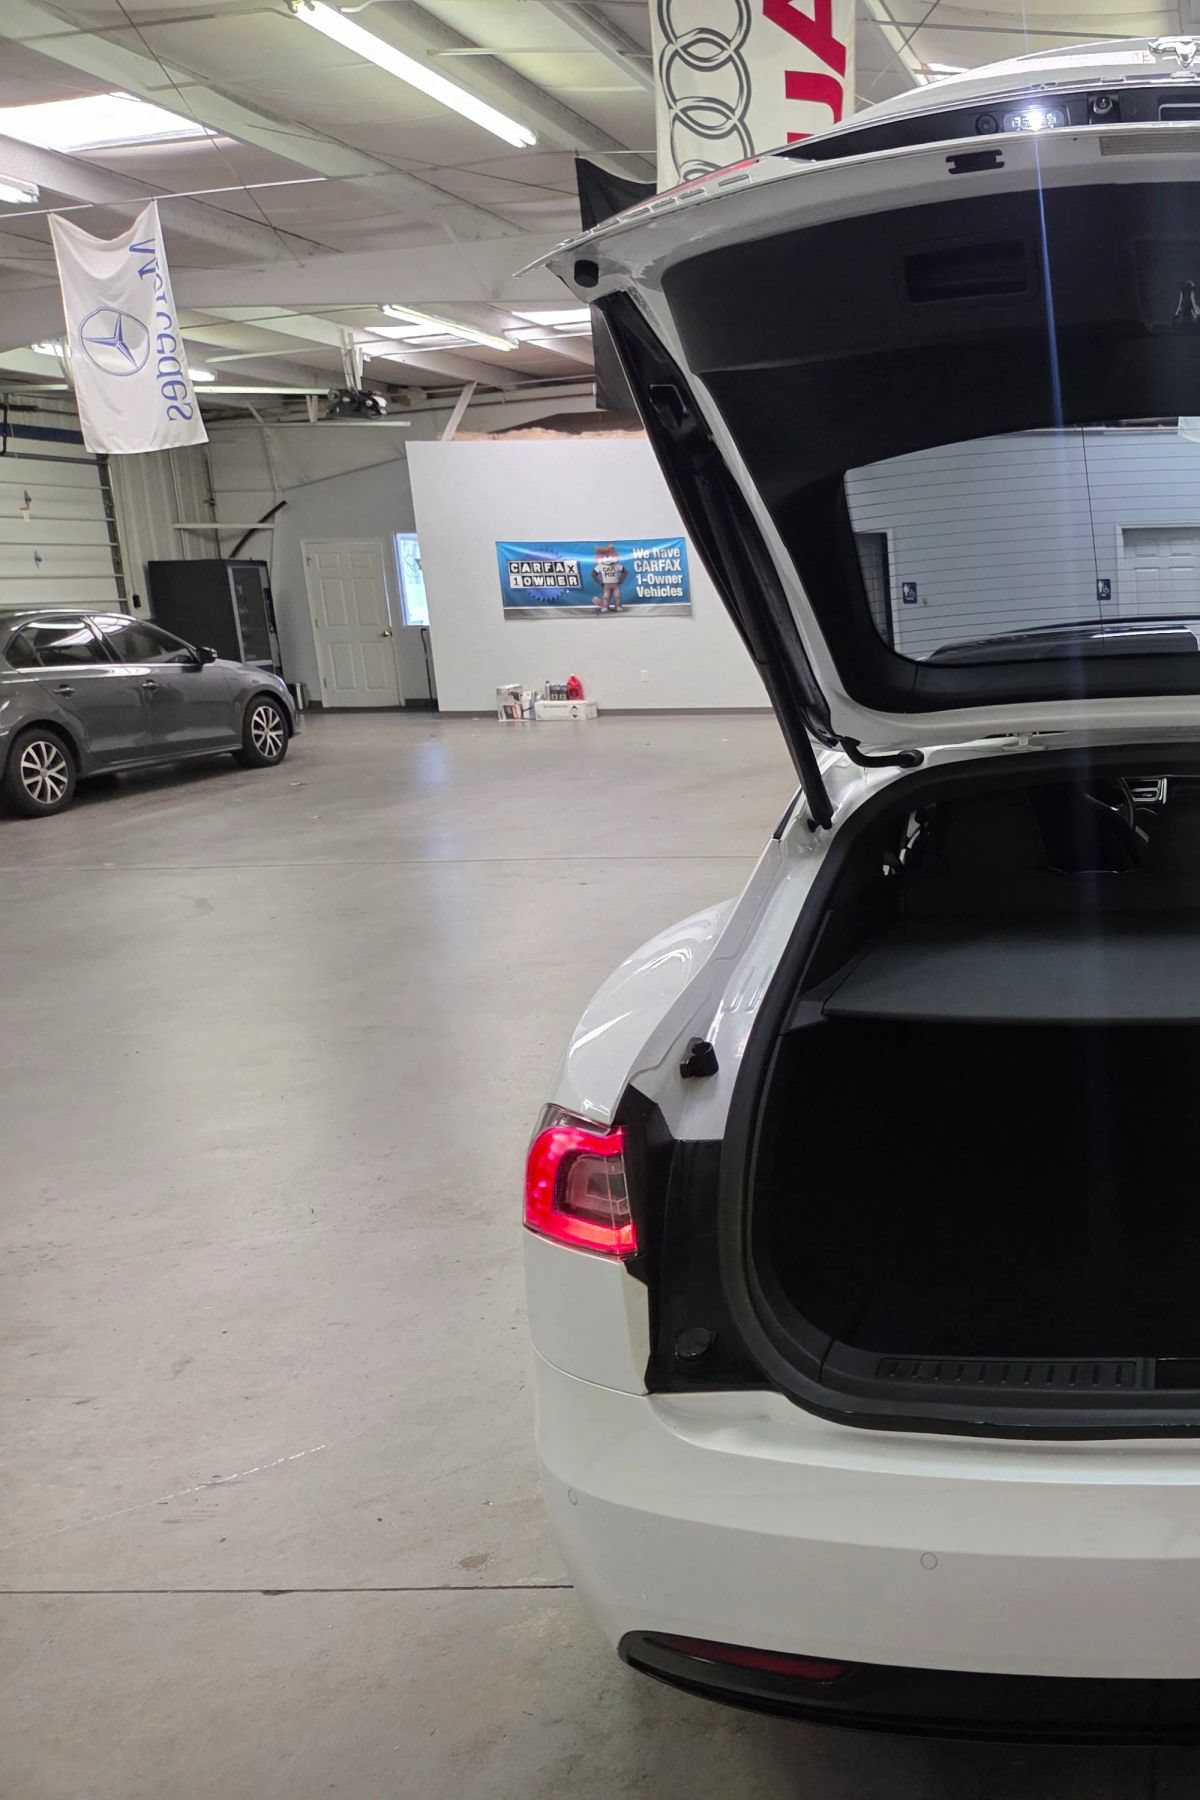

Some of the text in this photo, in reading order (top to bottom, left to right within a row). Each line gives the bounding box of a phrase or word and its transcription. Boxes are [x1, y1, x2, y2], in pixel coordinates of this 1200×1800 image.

[633, 547, 681, 559] We have
[510, 562, 575, 574] CARFAX
[633, 559, 682, 572] CARFAX
[636, 573, 683, 585] 1-Owner
[636, 586, 683, 598] Vehicles
